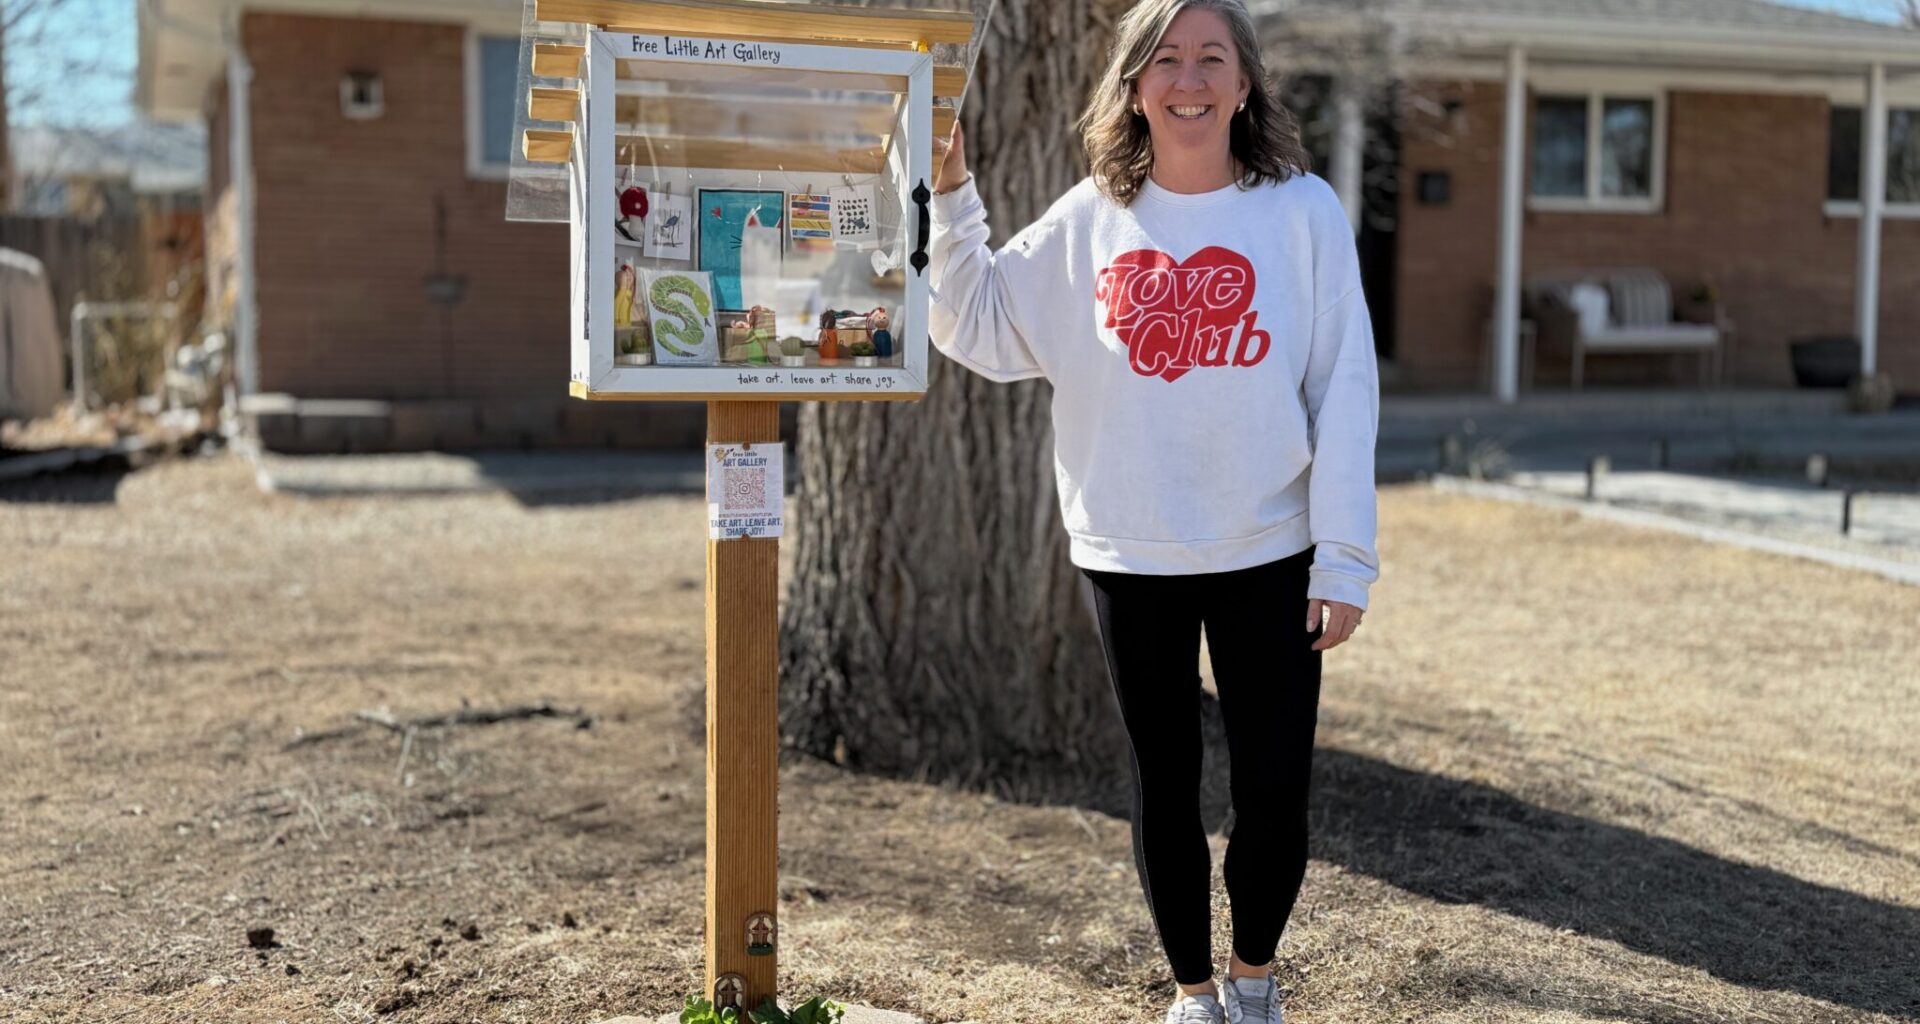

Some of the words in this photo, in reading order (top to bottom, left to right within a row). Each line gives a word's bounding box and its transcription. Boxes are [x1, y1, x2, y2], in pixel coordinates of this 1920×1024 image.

[632, 35, 658, 53] Free
[664, 36, 699, 56] Little
[704, 41, 726, 59] Art
[733, 42, 781, 64] Gallery
[1096, 264, 1246, 329] Love
[1128, 307, 1271, 376] Club
[737, 373, 759, 385] take
[765, 372, 783, 384] art.
[791, 373, 814, 384] leave
[845, 372, 872, 385] share
[876, 376, 896, 388] joy.
[723, 458, 736, 467] ART
[738, 457, 767, 467] GALLERY
[711, 519, 727, 527] TAKE
[745, 518, 766, 527] LEAVE
[767, 517, 783, 526] ART.
[726, 527, 748, 536] SHARE
[749, 526, 765, 535] JOY!
